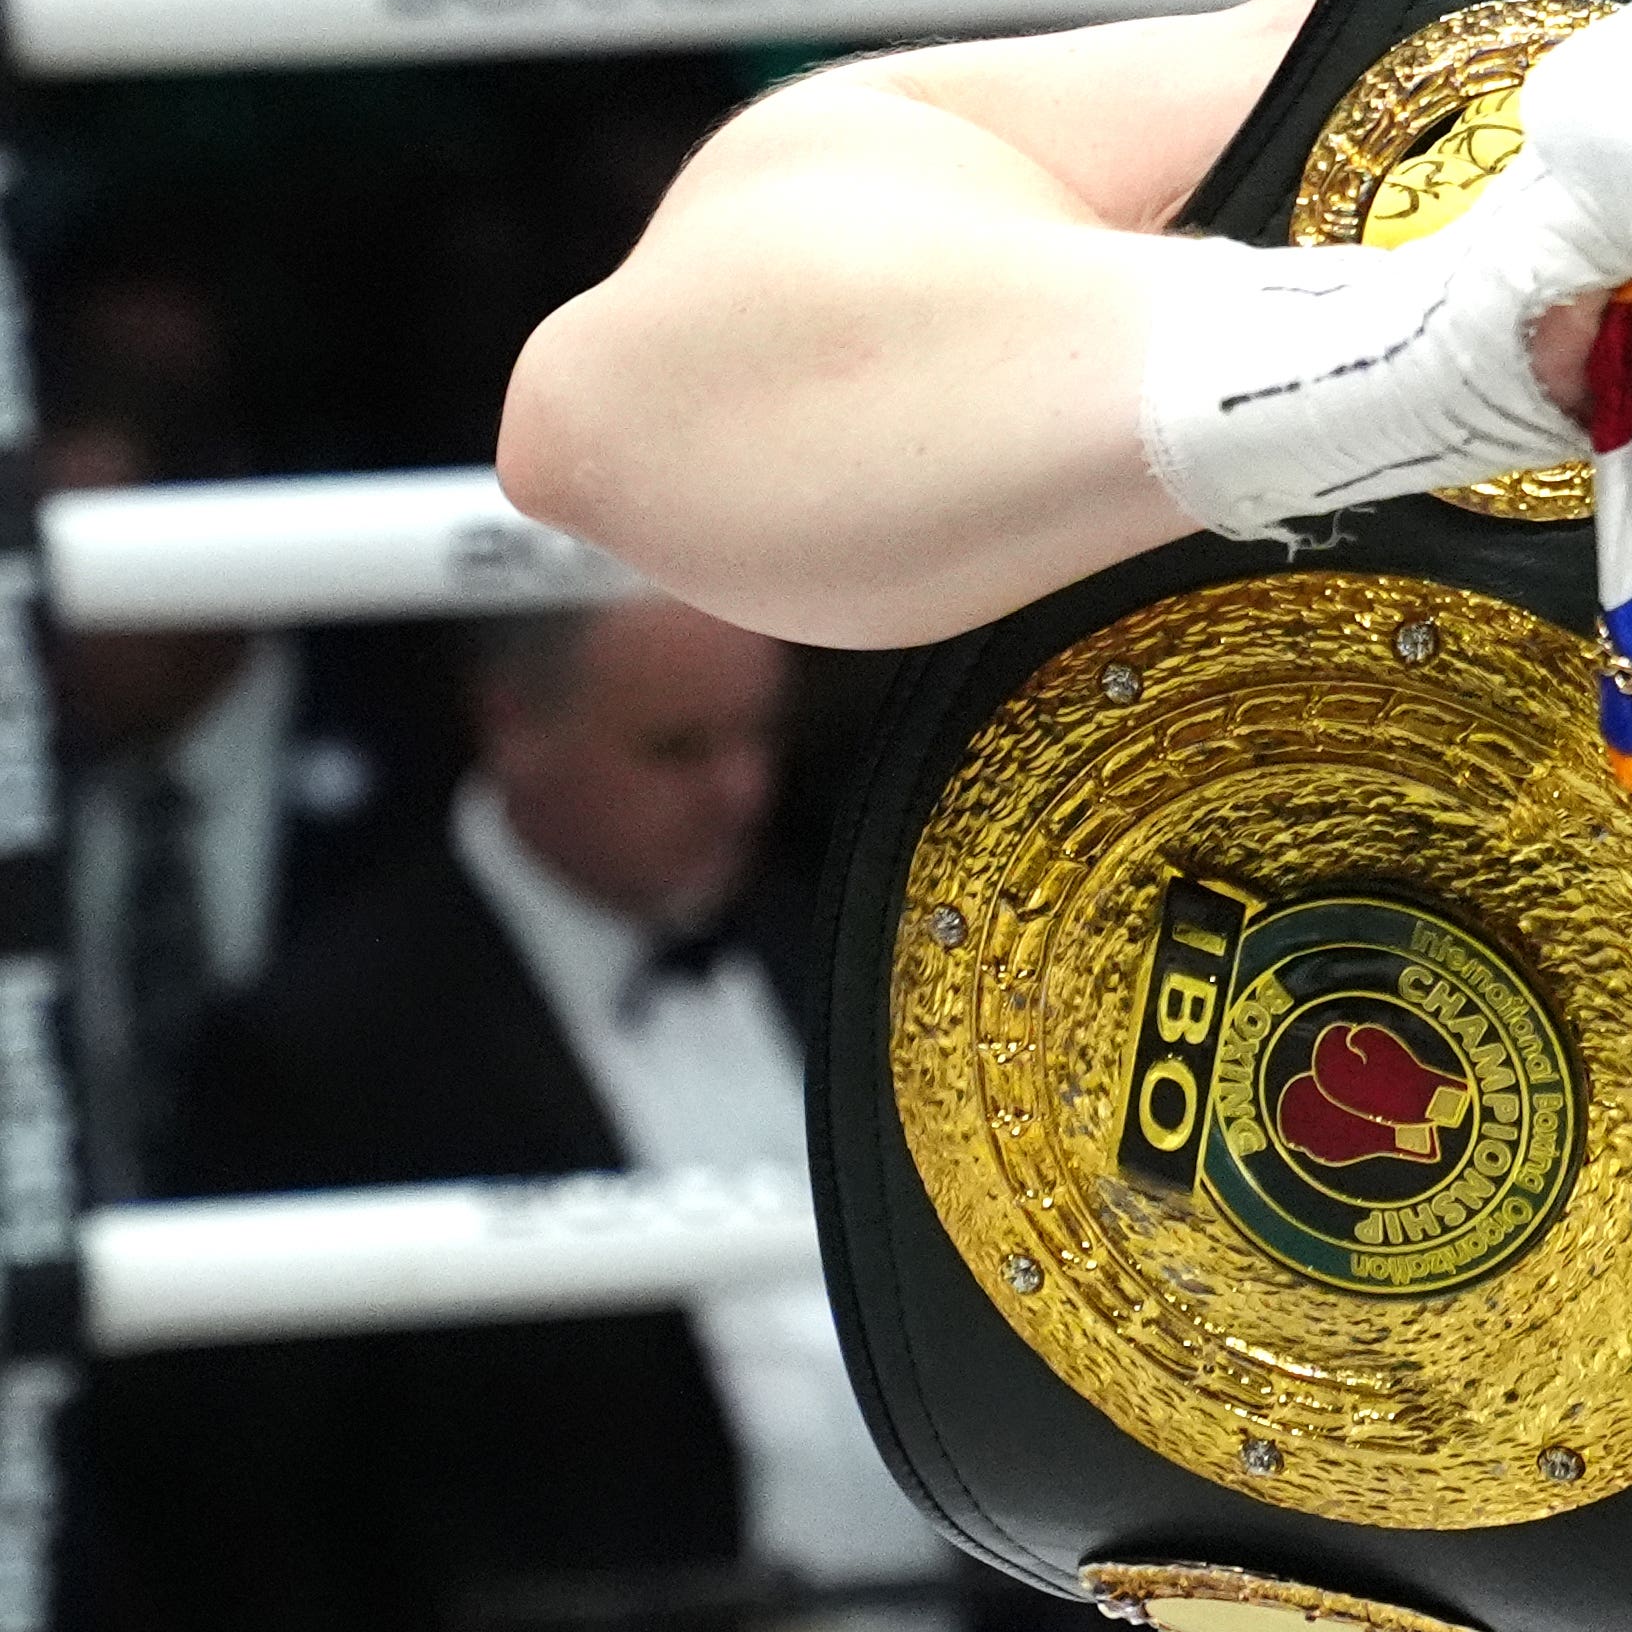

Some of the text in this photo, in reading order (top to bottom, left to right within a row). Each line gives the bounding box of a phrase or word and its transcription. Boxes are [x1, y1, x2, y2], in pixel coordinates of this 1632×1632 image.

[1138, 922, 1227, 1153] IBO
[1214, 974, 1295, 1158] BOXING
[1351, 920, 1565, 1285] International Boxing Organization
[1354, 965, 1521, 1245] CHAMPIONSHIP
